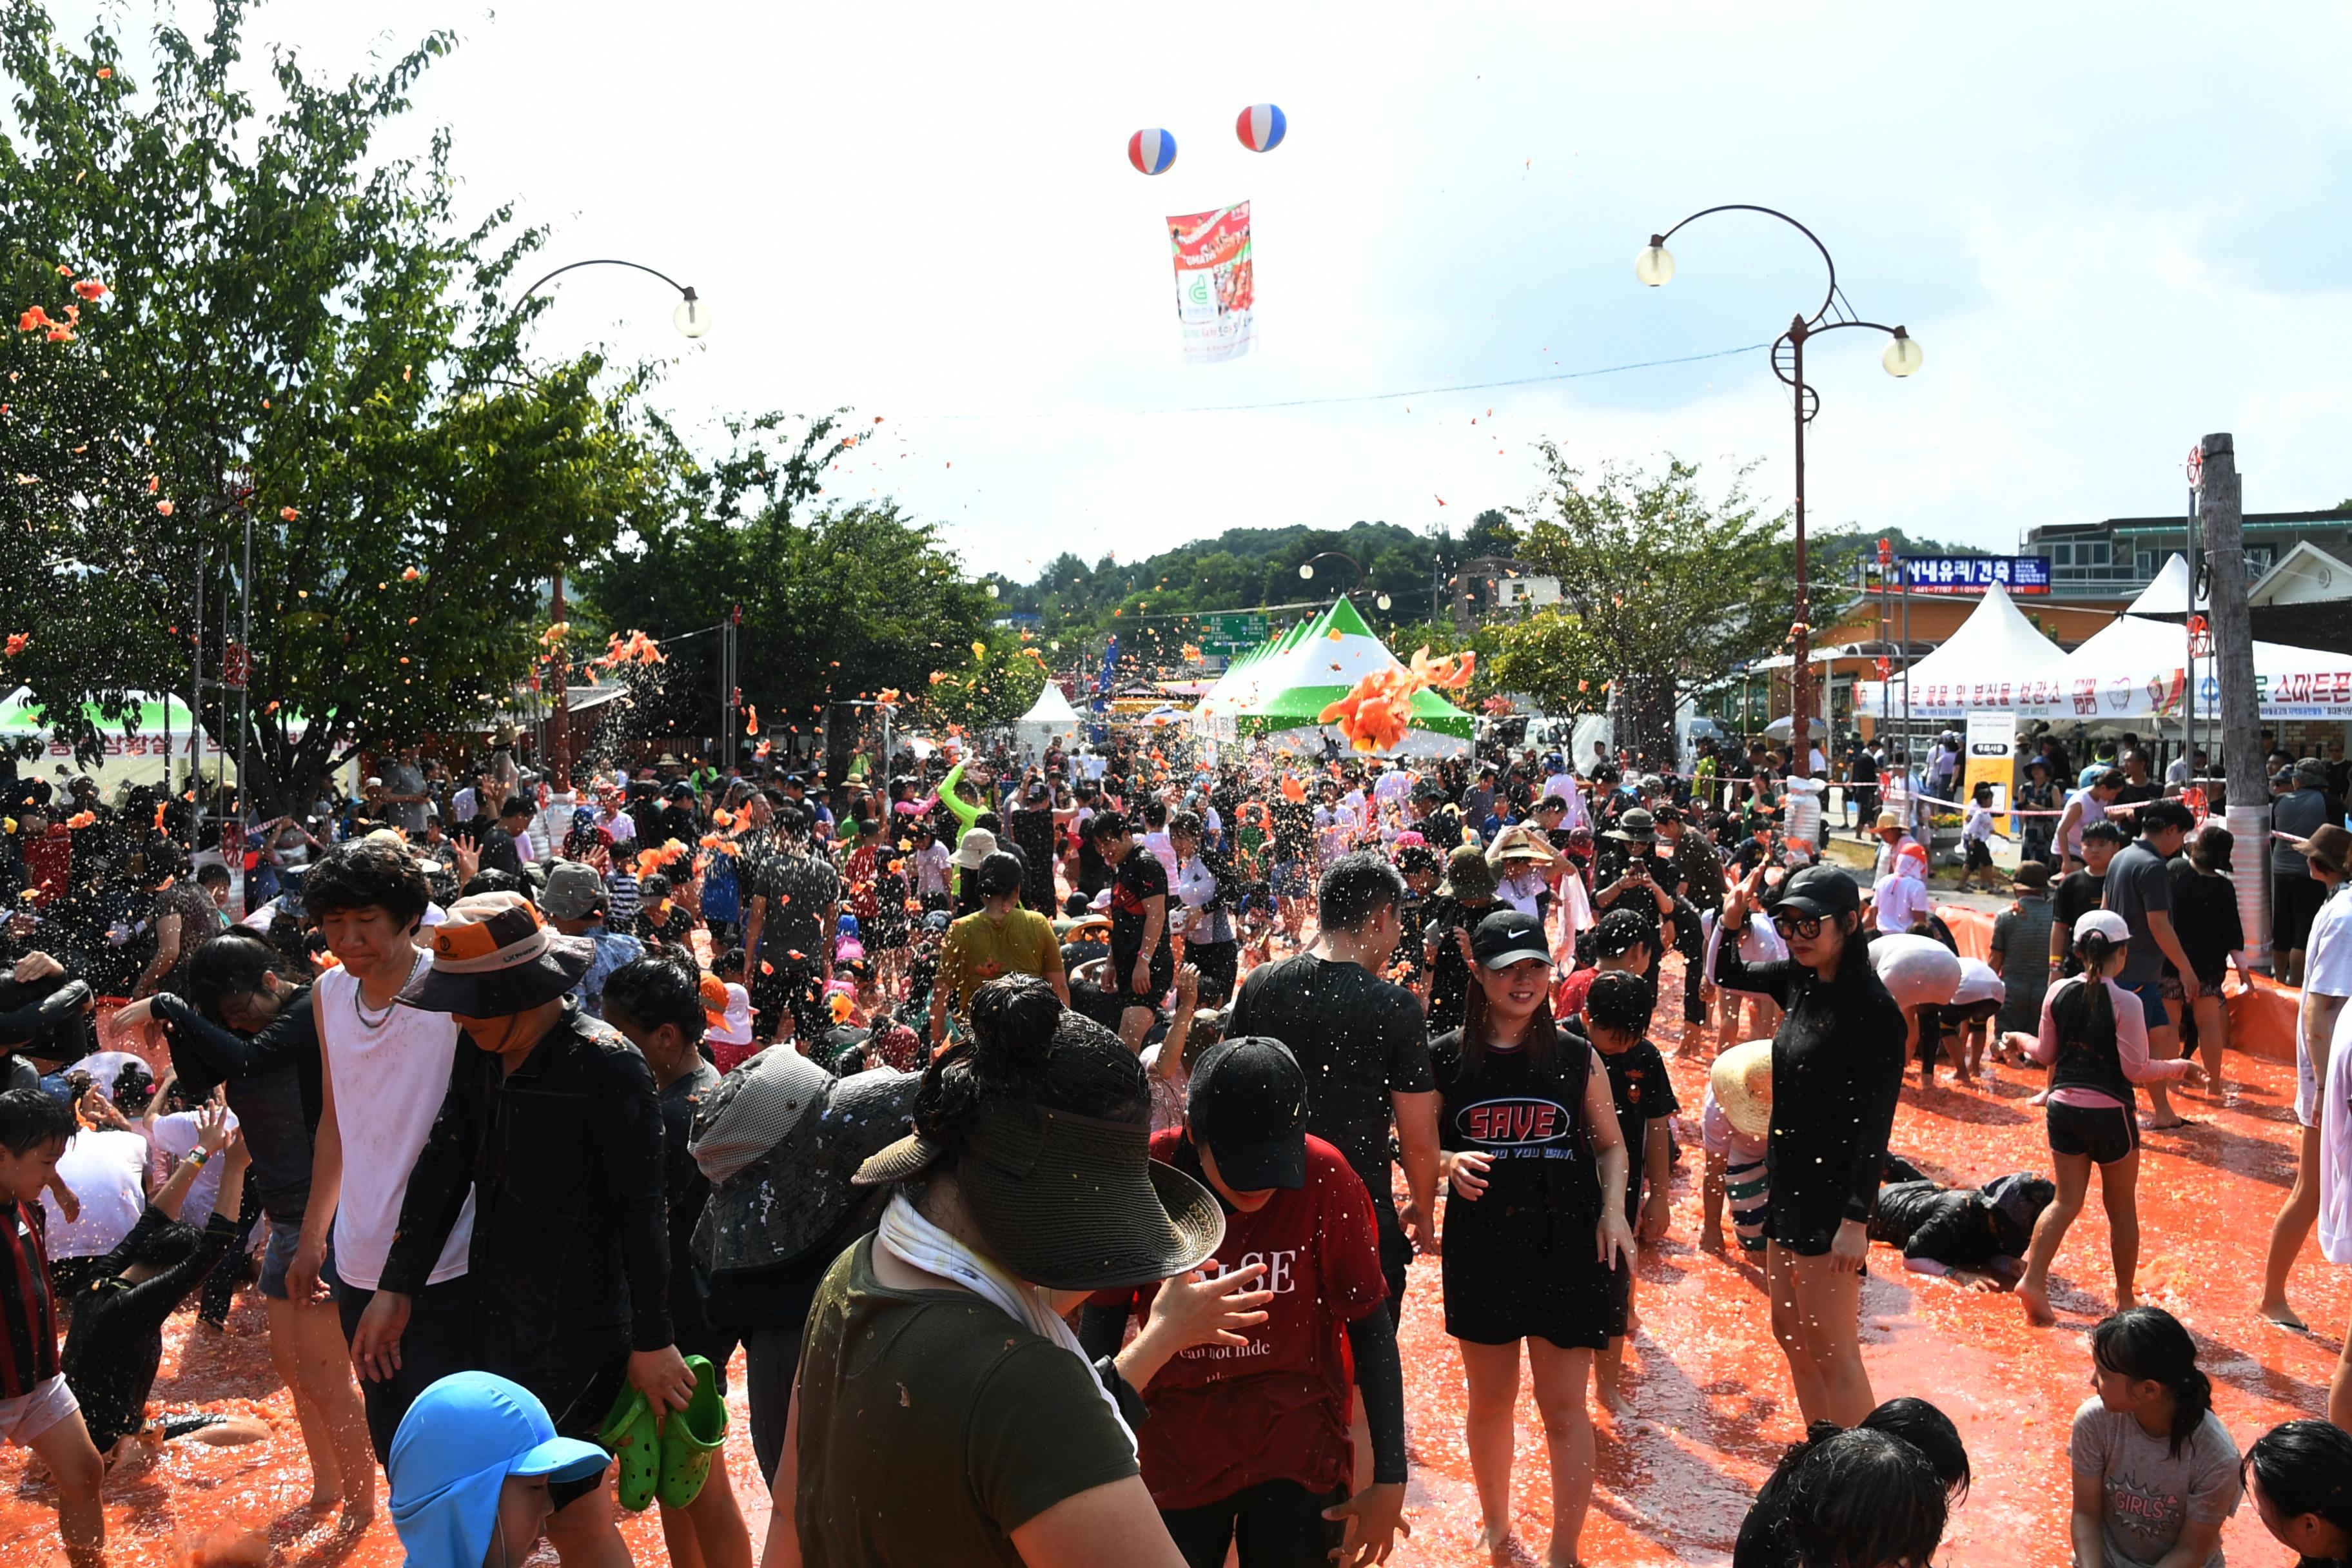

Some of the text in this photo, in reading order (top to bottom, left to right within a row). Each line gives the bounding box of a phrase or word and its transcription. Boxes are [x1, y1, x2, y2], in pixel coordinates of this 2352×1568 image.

[2274, 672, 2352, 703] 스마트폰
[50, 734, 173, 756] 종상황실
[1469, 1104, 1556, 1141] SAVE
[1513, 1148, 1540, 1159] YOU
[1179, 1339, 1271, 1359] can not hide
[2115, 1491, 2165, 1518] GIRLS
